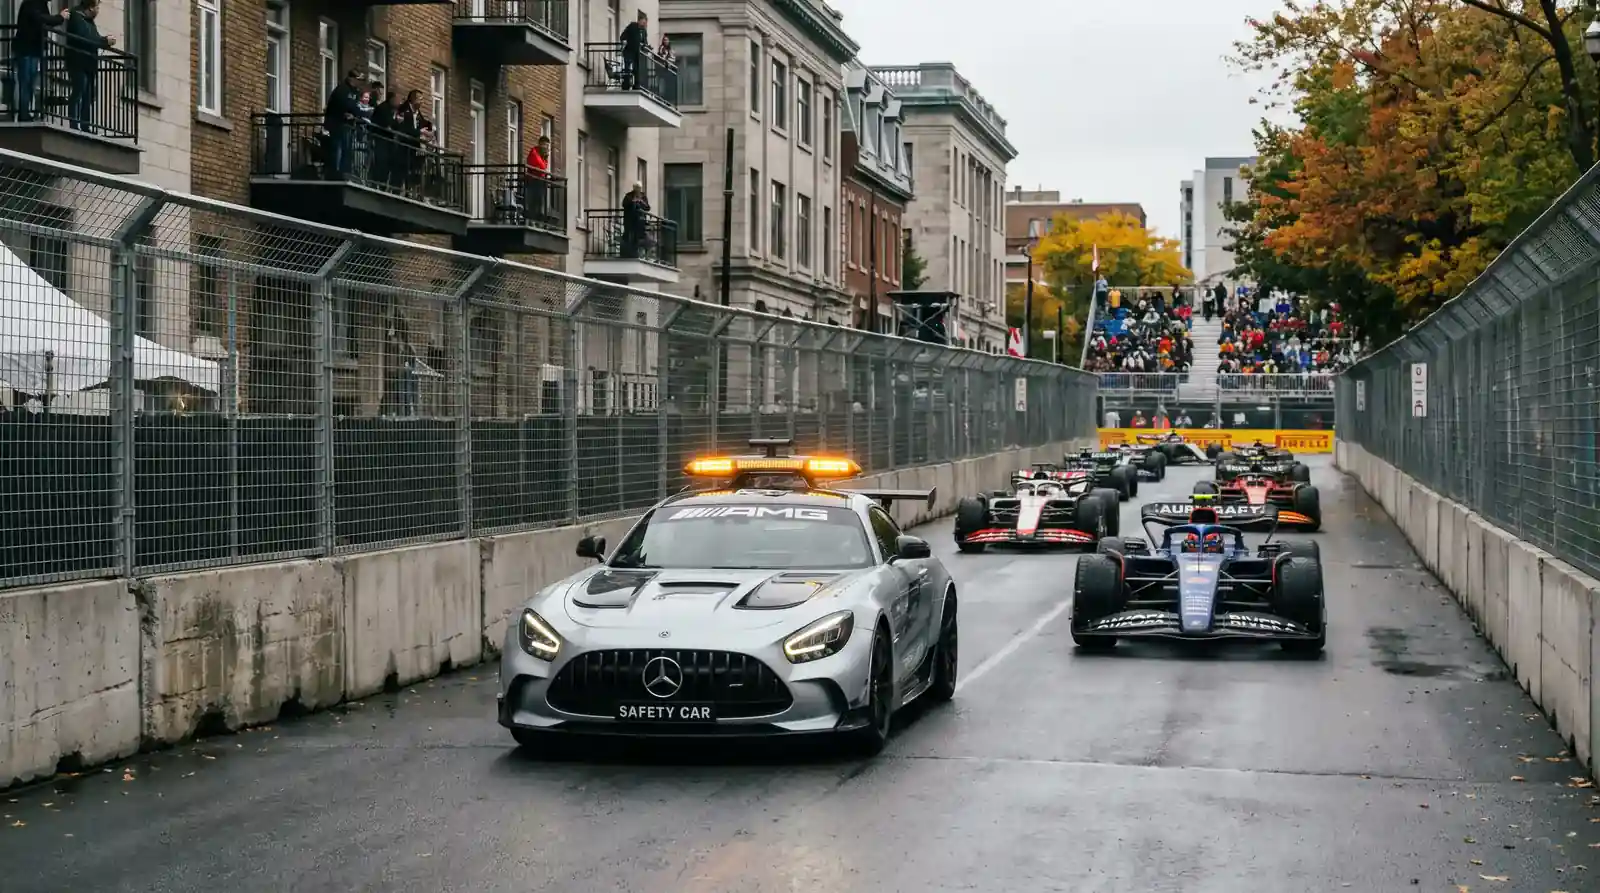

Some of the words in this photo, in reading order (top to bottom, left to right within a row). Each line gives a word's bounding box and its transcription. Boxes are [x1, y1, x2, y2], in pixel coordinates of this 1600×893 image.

[721, 506, 828, 521] AMG
[619, 705, 675, 718] SAFETY
[680, 706, 711, 719] CAR
